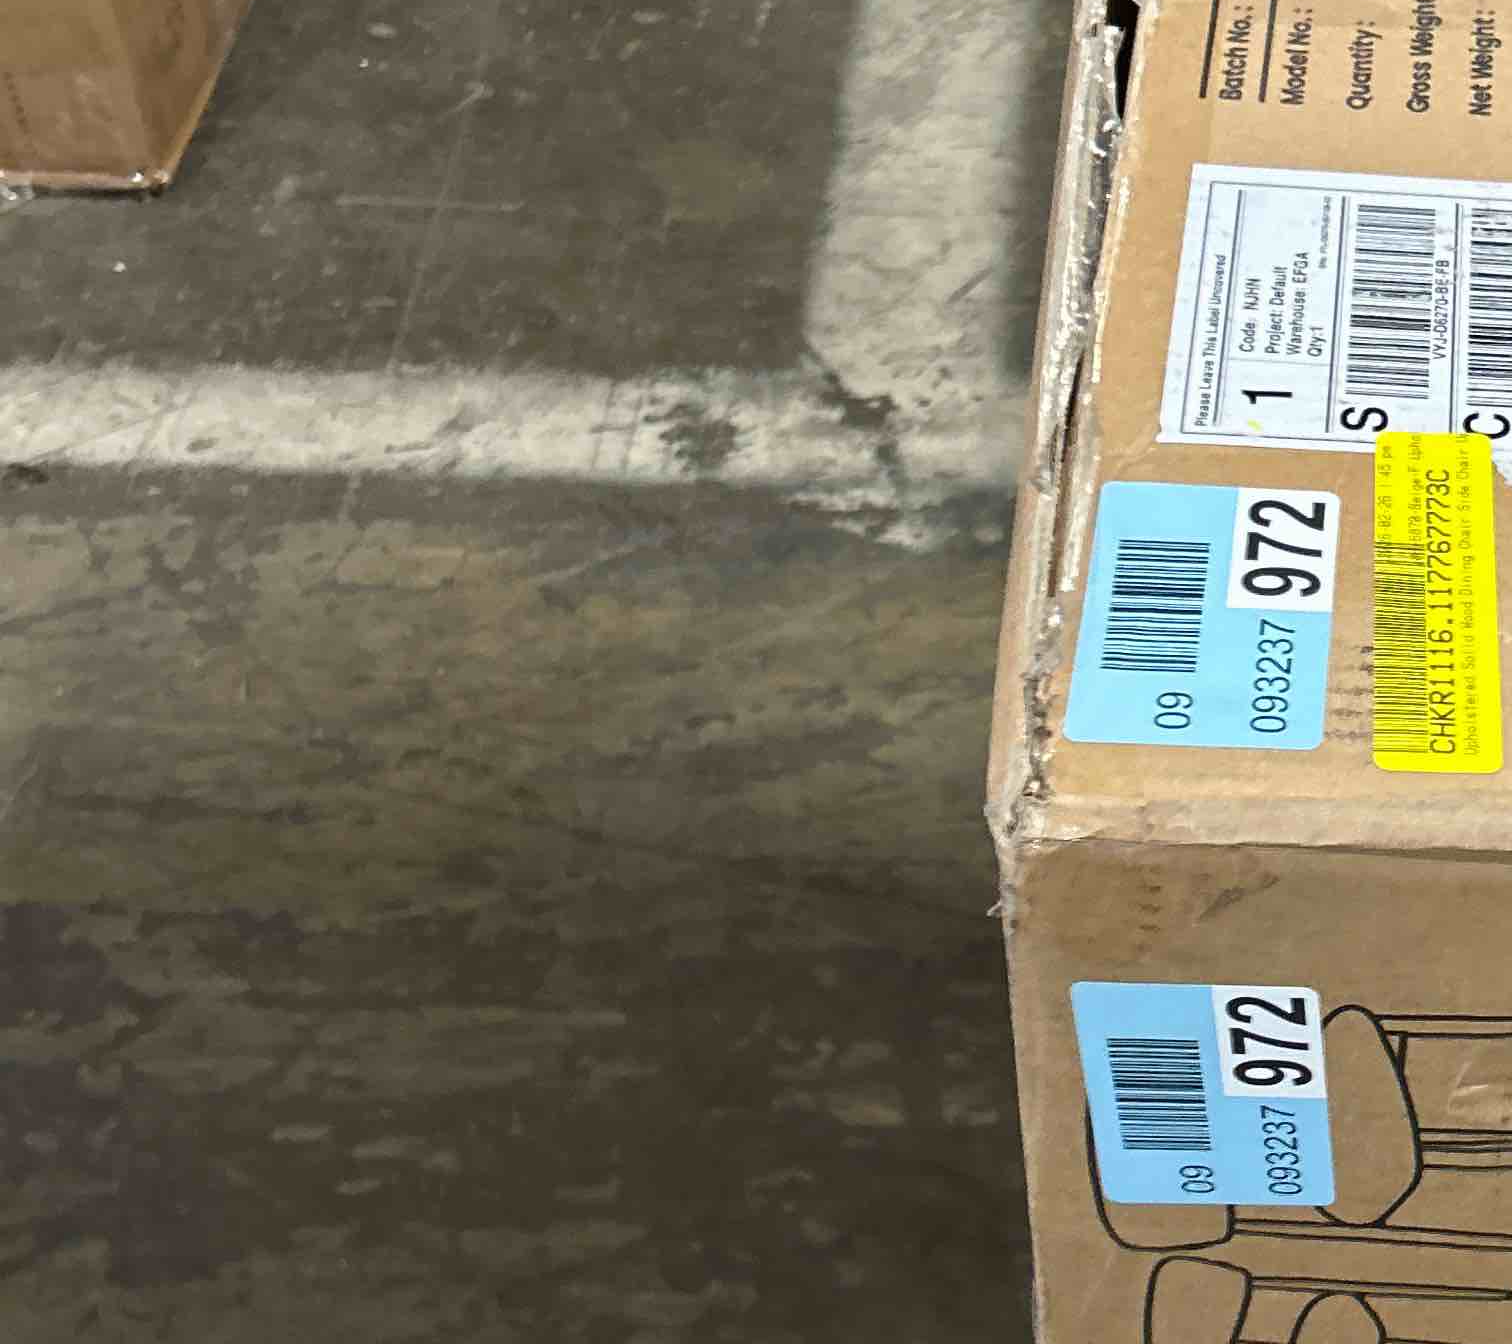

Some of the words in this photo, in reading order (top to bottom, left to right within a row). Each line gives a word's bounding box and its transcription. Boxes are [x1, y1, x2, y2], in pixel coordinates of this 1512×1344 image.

[1472, 10, 1501, 78] Weight:
[1219, 47, 1249, 101] Batch
[1281, 51, 1308, 105] Model
[1346, 21, 1382, 110] Quantity:
[1407, 63, 1431, 113] Gross
[1470, 85, 1492, 116] Net
[1210, 254, 1226, 305] Uncovered
[1245, 278, 1261, 310] NJHN
[1268, 266, 1288, 306] Default
[1207, 308, 1220, 334] Label
[1239, 318, 1257, 353] Code:
[1264, 310, 1284, 354] Project:
[1286, 287, 1306, 355] Warehouse:
[1203, 337, 1217, 357] This
[1201, 361, 1215, 390] Leave
[1195, 393, 1211, 427] Please
[1241, 389, 1293, 405] 1
[1340, 407, 1388, 432] S
[1462, 412, 1511, 440] C
[1240, 499, 1326, 598] 972
[1426, 469, 1456, 754] CHKR1116.117767773C
[1249, 619, 1297, 734] 093237
[1153, 692, 1193, 731] 09
[1224, 996, 1313, 1086] 972
[1260, 1105, 1303, 1195] 093237
[1179, 1164, 1216, 1194] 09
